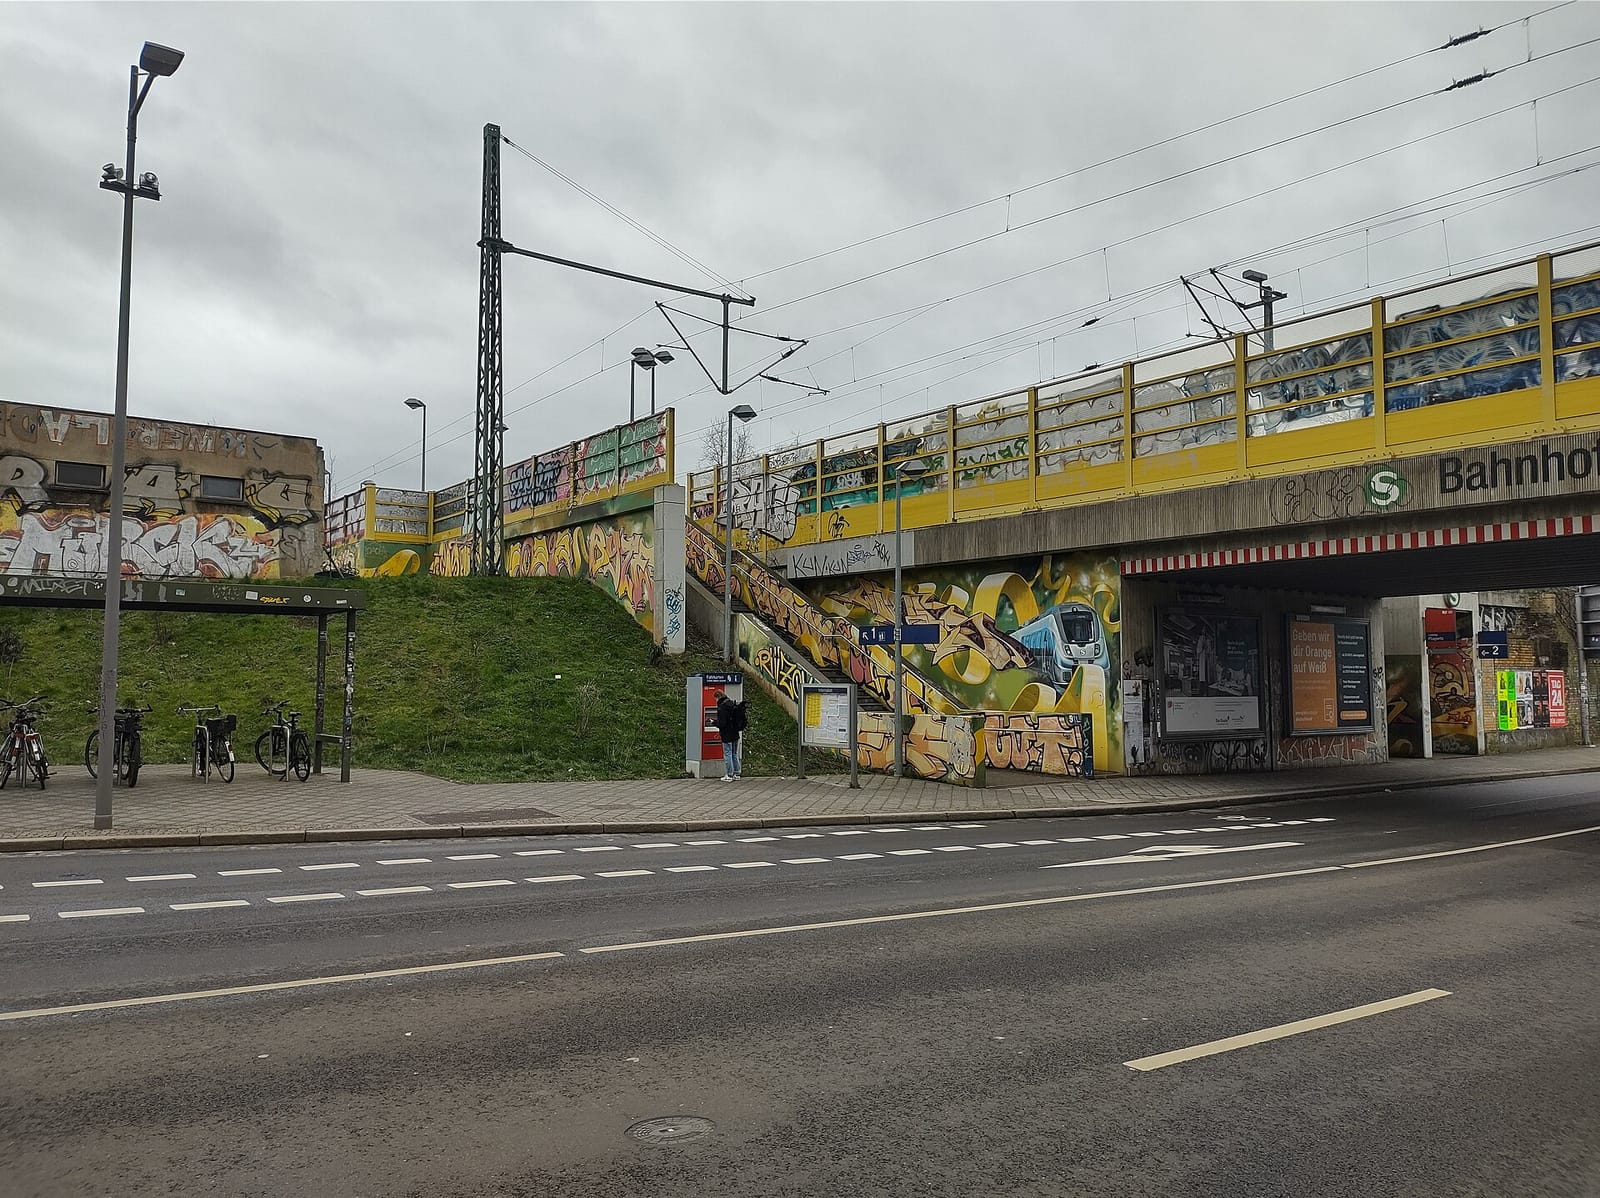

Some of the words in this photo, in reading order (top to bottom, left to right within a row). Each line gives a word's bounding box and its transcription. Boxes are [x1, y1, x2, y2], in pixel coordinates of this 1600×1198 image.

[871, 626, 876, 639] 1
[1318, 631, 1330, 642] wir
[1293, 645, 1305, 656] dir
[1305, 645, 1333, 660] Orange
[1492, 645, 1499, 655] 2
[1293, 661, 1307, 673] auf
[1307, 661, 1327, 673] Weiß
